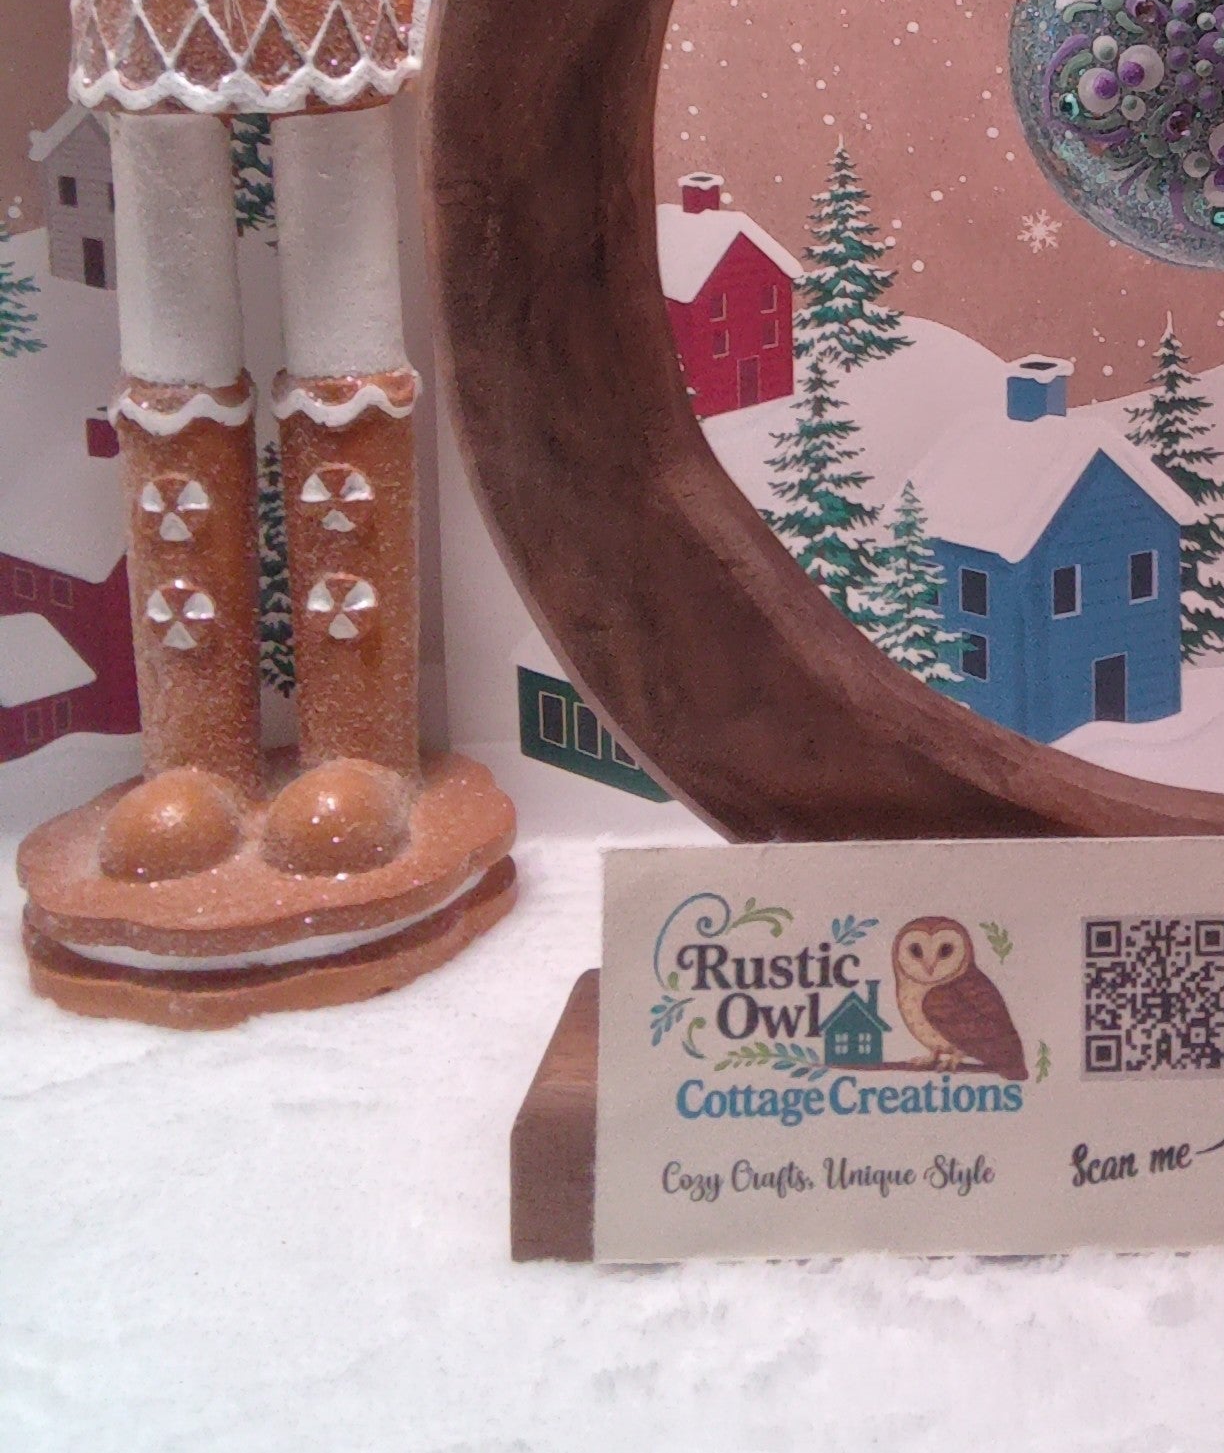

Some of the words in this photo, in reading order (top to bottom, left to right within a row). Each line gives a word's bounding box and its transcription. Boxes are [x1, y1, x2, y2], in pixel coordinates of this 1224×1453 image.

[676, 942, 861, 991] Rustic
[716, 992, 823, 1040] Owl
[676, 1078, 826, 1127] Cottage
[828, 1075, 1024, 1115] Creations
[661, 1160, 723, 1202] Cozy
[730, 1159, 815, 1199] Crafts,
[823, 1156, 917, 1198] Unique
[922, 1153, 996, 1197] Style
[1070, 1143, 1139, 1188] Scan
[1149, 1143, 1193, 1174] me
